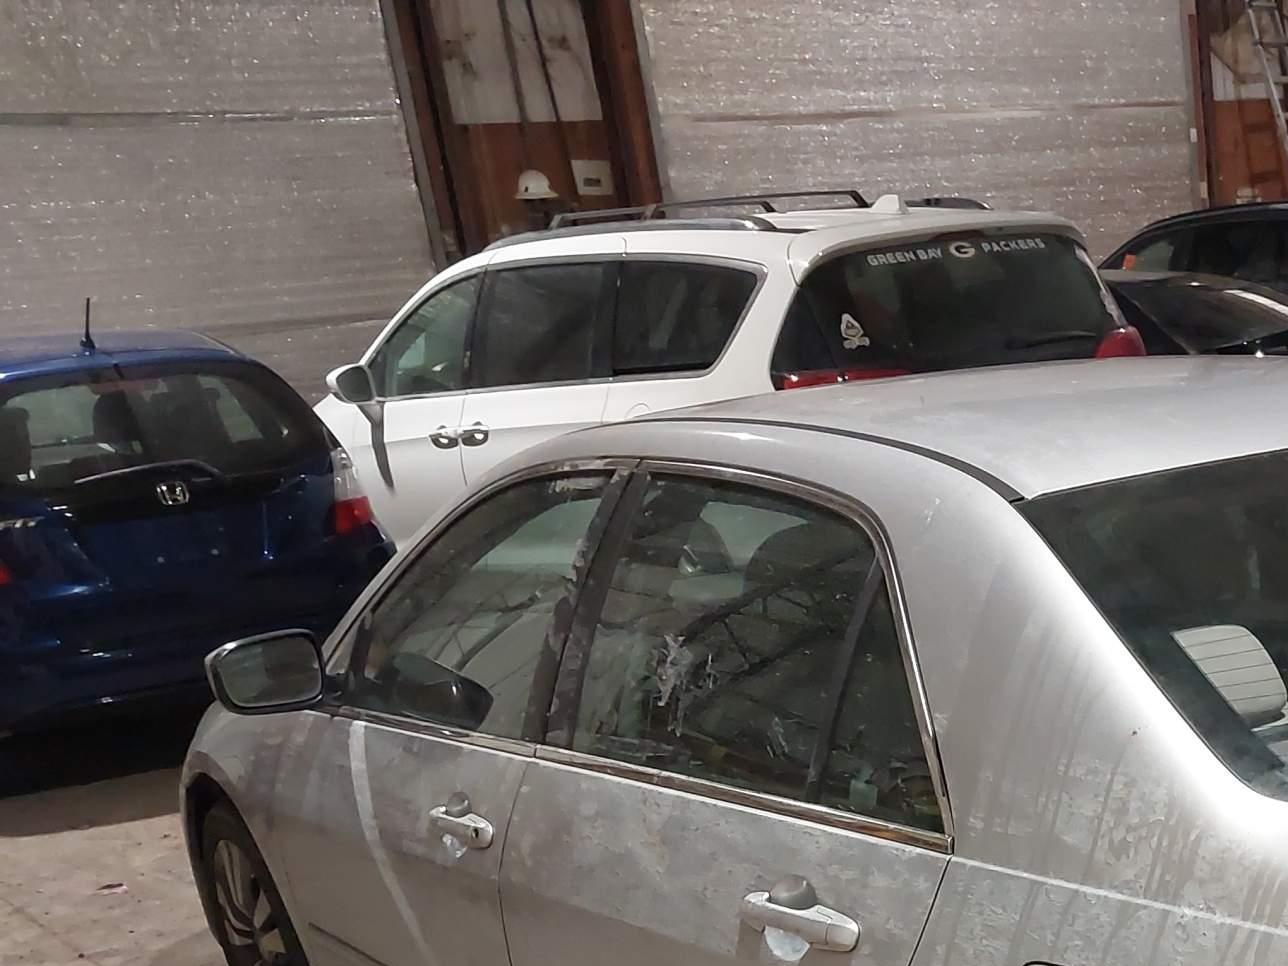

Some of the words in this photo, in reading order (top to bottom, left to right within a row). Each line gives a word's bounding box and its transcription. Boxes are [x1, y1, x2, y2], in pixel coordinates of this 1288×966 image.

[867, 251, 917, 266] GREEN
[918, 248, 943, 260] BAY
[981, 238, 1045, 253] PACKERS
